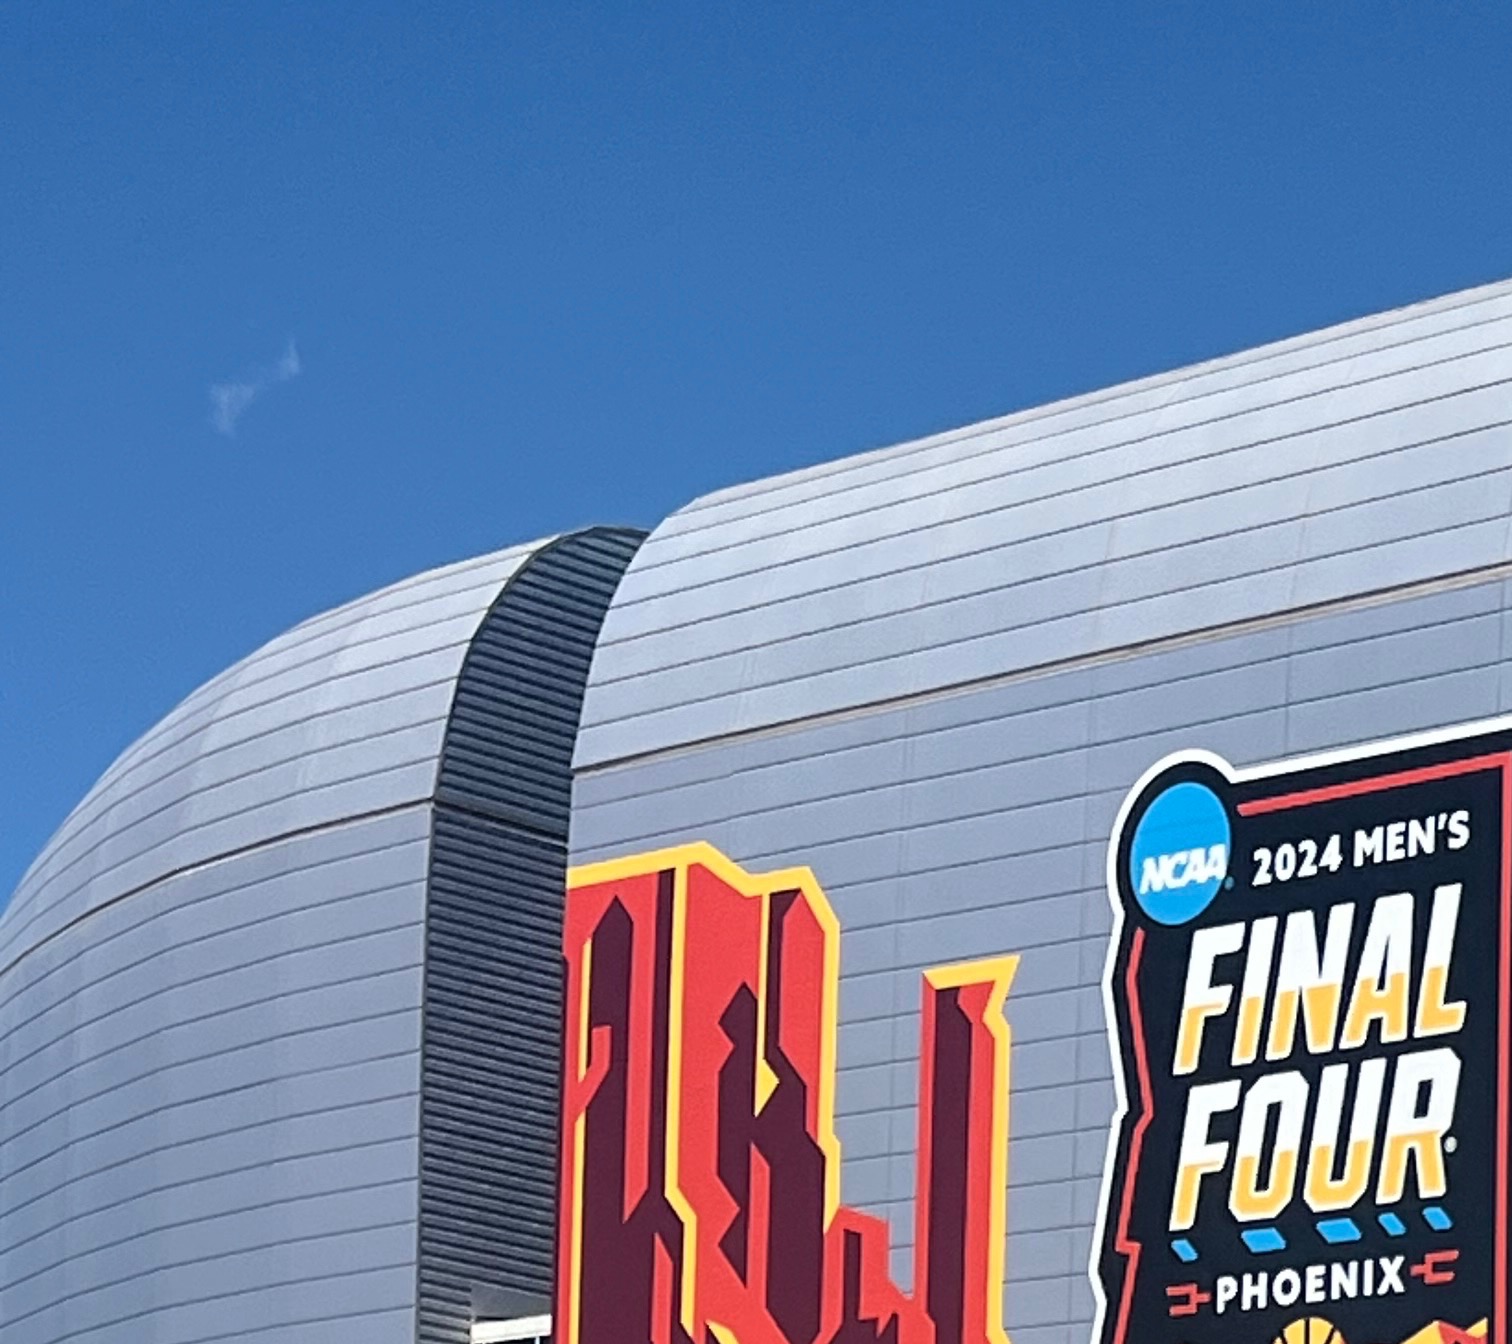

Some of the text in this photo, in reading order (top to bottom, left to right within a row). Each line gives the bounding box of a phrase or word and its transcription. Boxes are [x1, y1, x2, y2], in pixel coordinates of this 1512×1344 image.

[1139, 843, 1228, 895] NCAA
[1252, 810, 1470, 887] 2024 MEN'S
[1172, 882, 1467, 1076] FINAL
[1168, 1046, 1461, 1233] FOUR
[1214, 1254, 1406, 1314] PHOENIX
